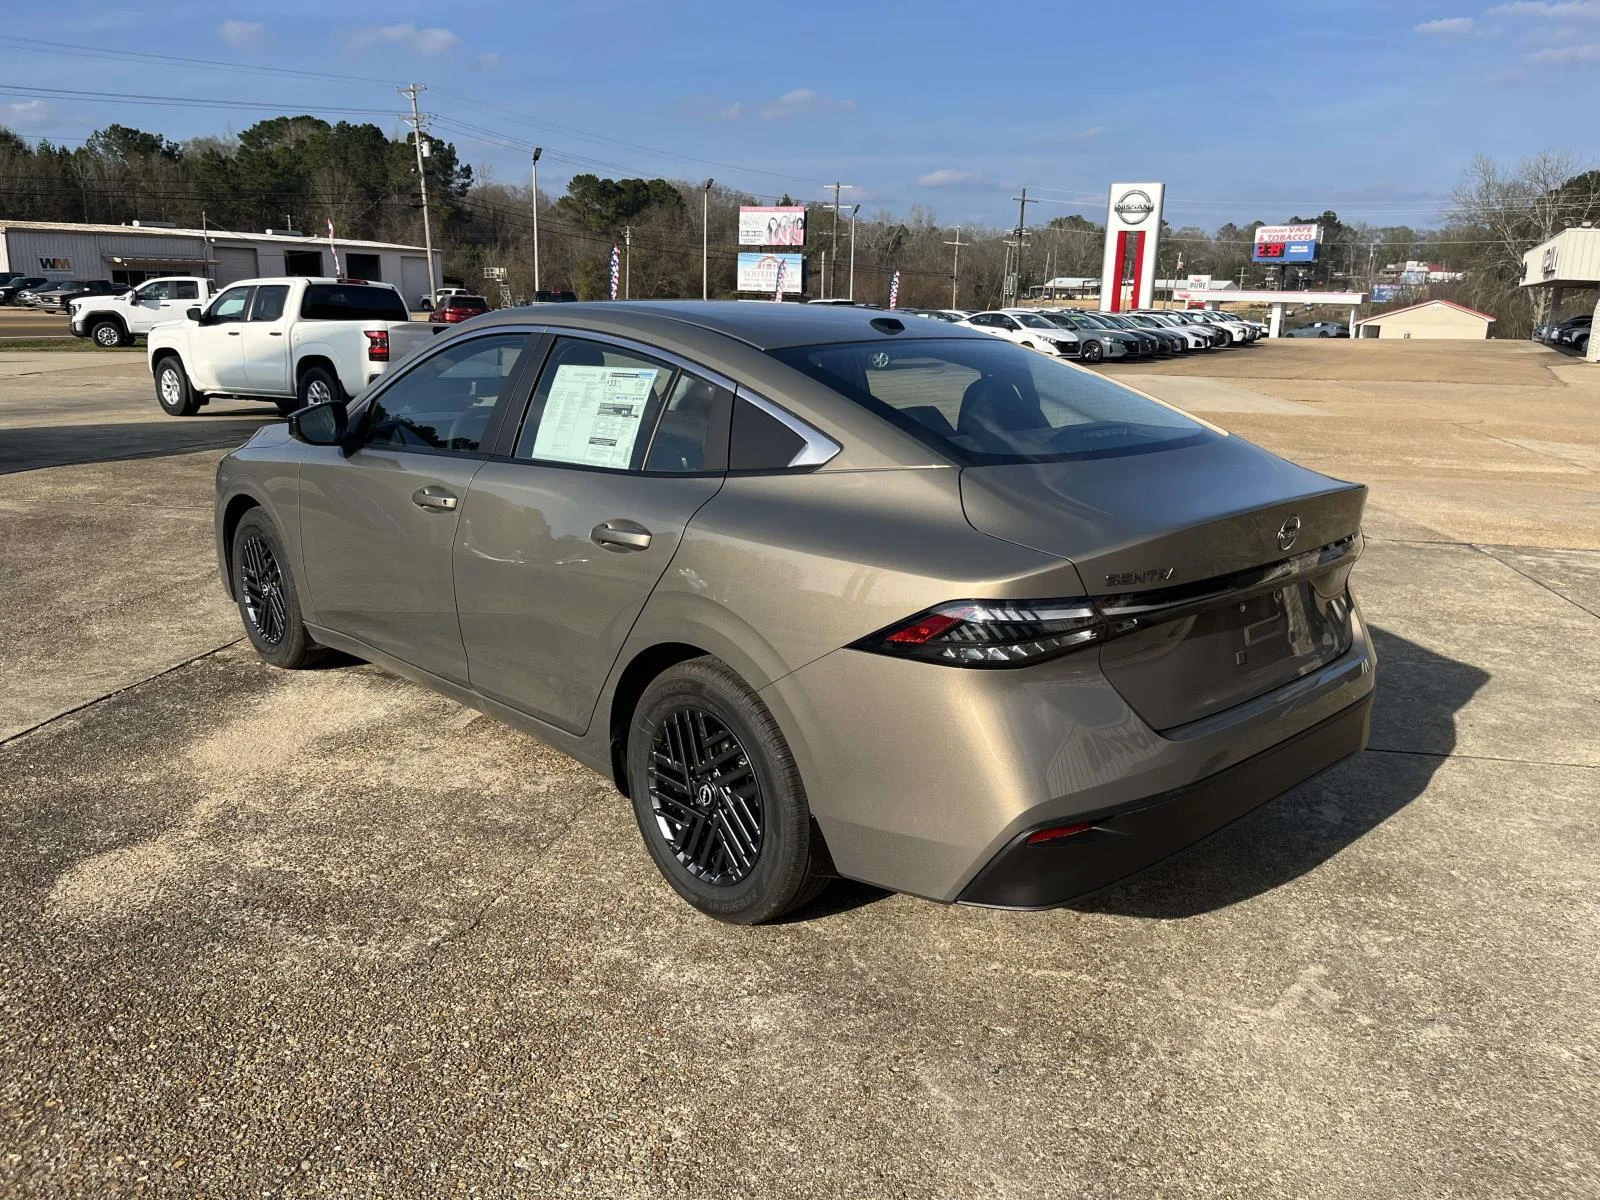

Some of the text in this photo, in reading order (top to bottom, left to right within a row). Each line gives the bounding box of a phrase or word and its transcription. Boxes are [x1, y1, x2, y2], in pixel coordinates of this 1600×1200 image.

[1289, 225, 1313, 233] VAPE
[1268, 233, 1312, 242] TOBACCO
[39, 257, 71, 269] WM
[1104, 567, 1176, 586] SENTRA
